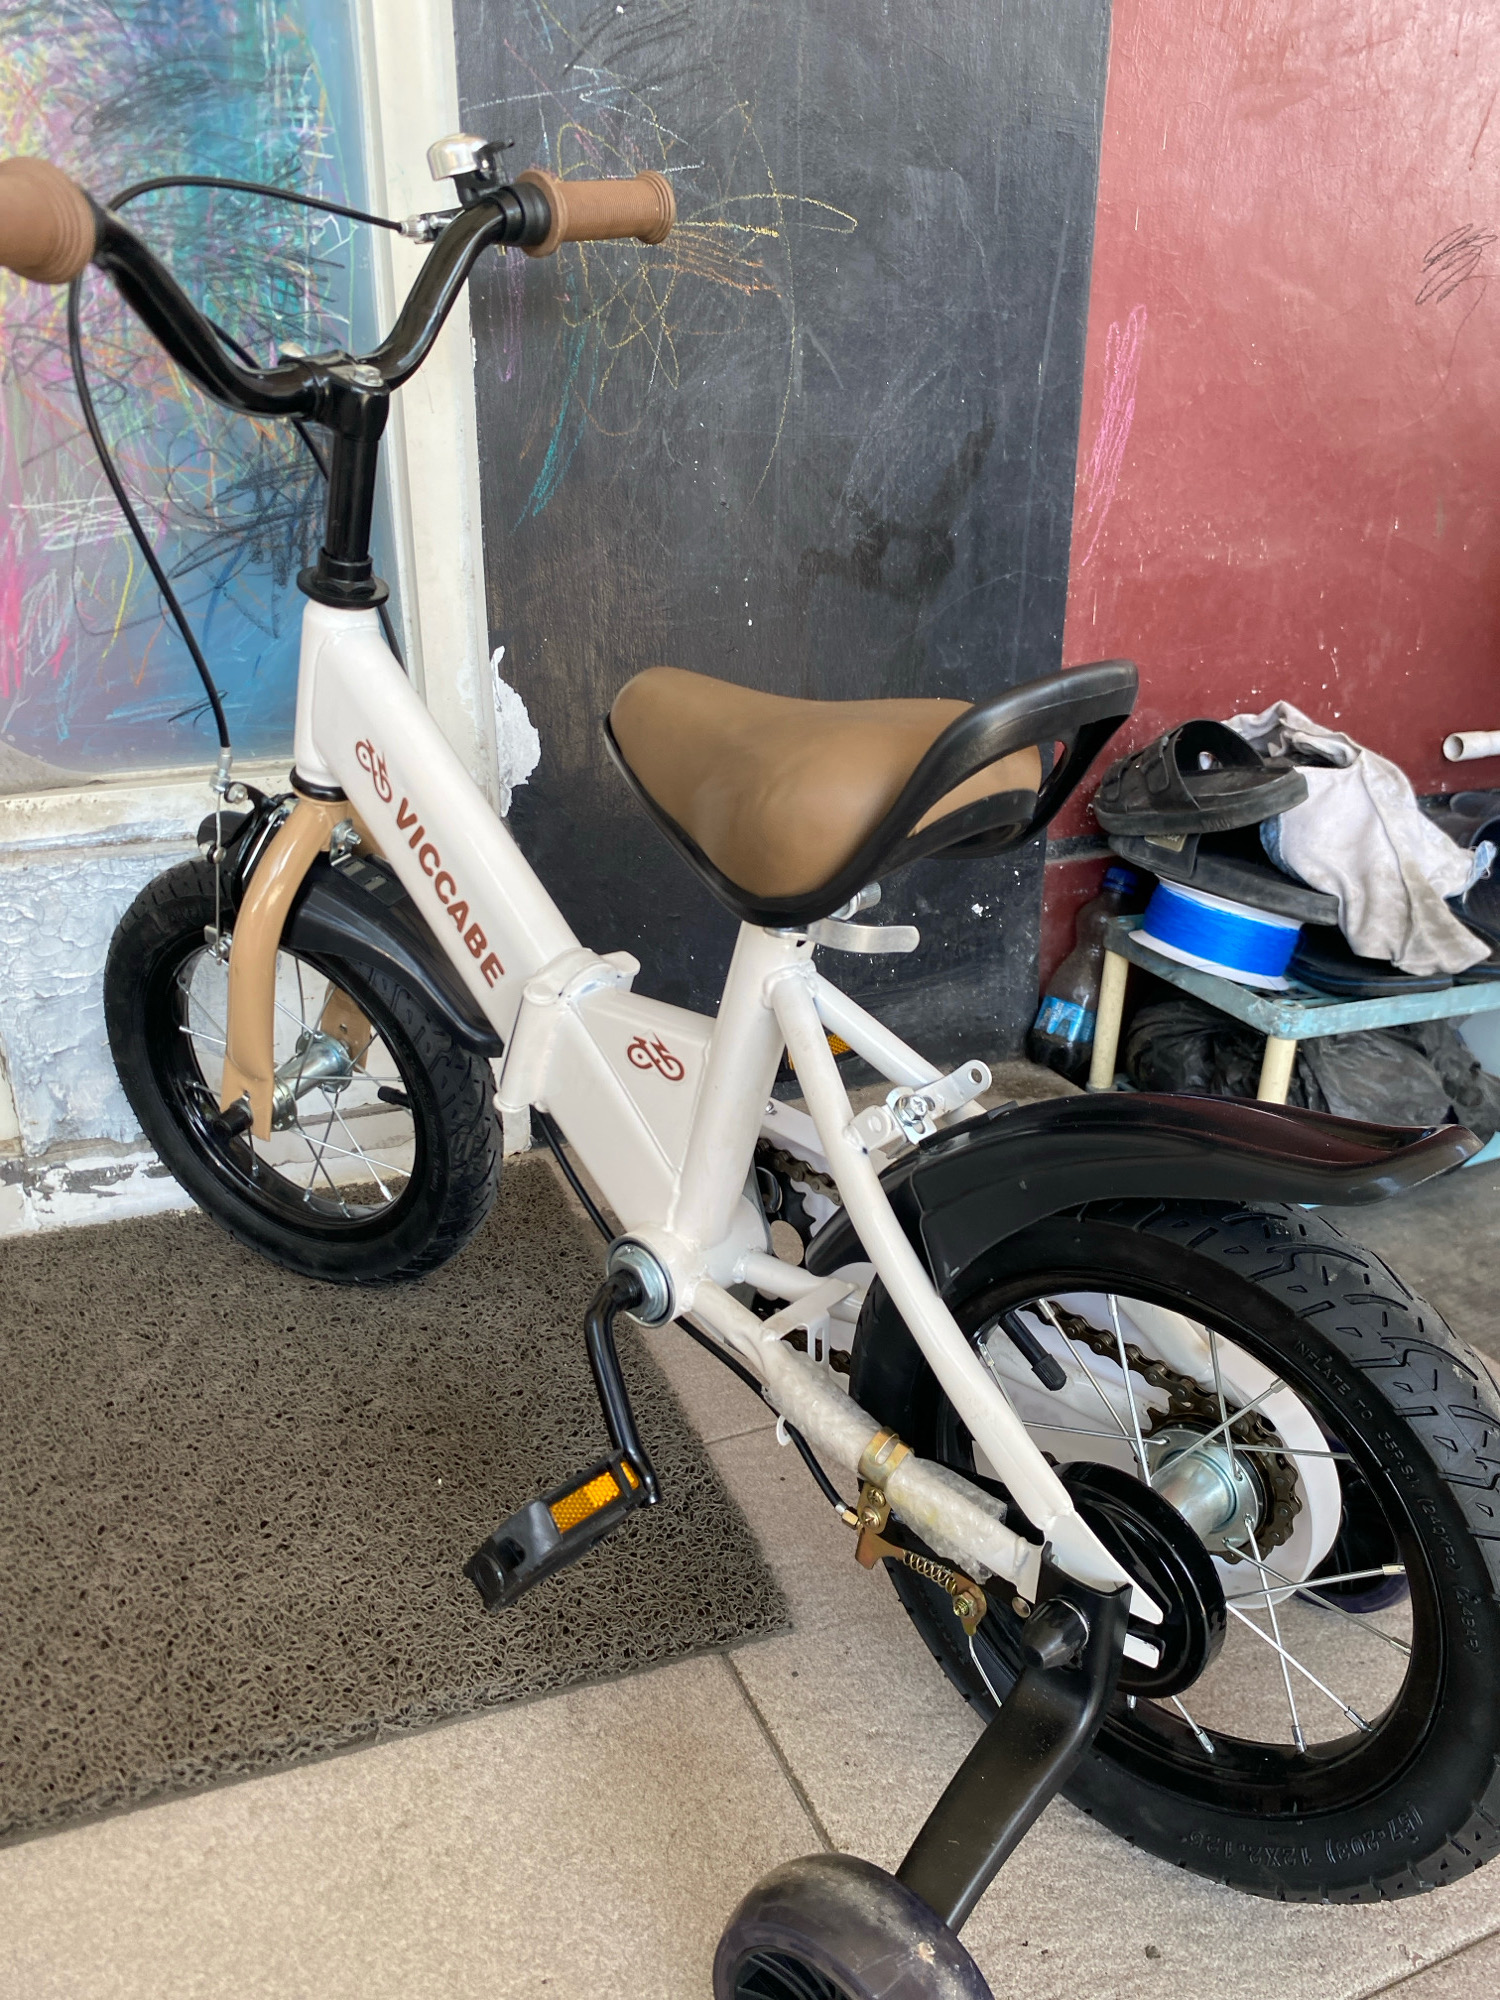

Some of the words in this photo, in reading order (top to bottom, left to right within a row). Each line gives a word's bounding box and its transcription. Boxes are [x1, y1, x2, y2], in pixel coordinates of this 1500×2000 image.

[396, 797, 505, 989] VICCABE
[1294, 1341, 1351, 1396] INFLATE
[1353, 1399, 1373, 1421] TO
